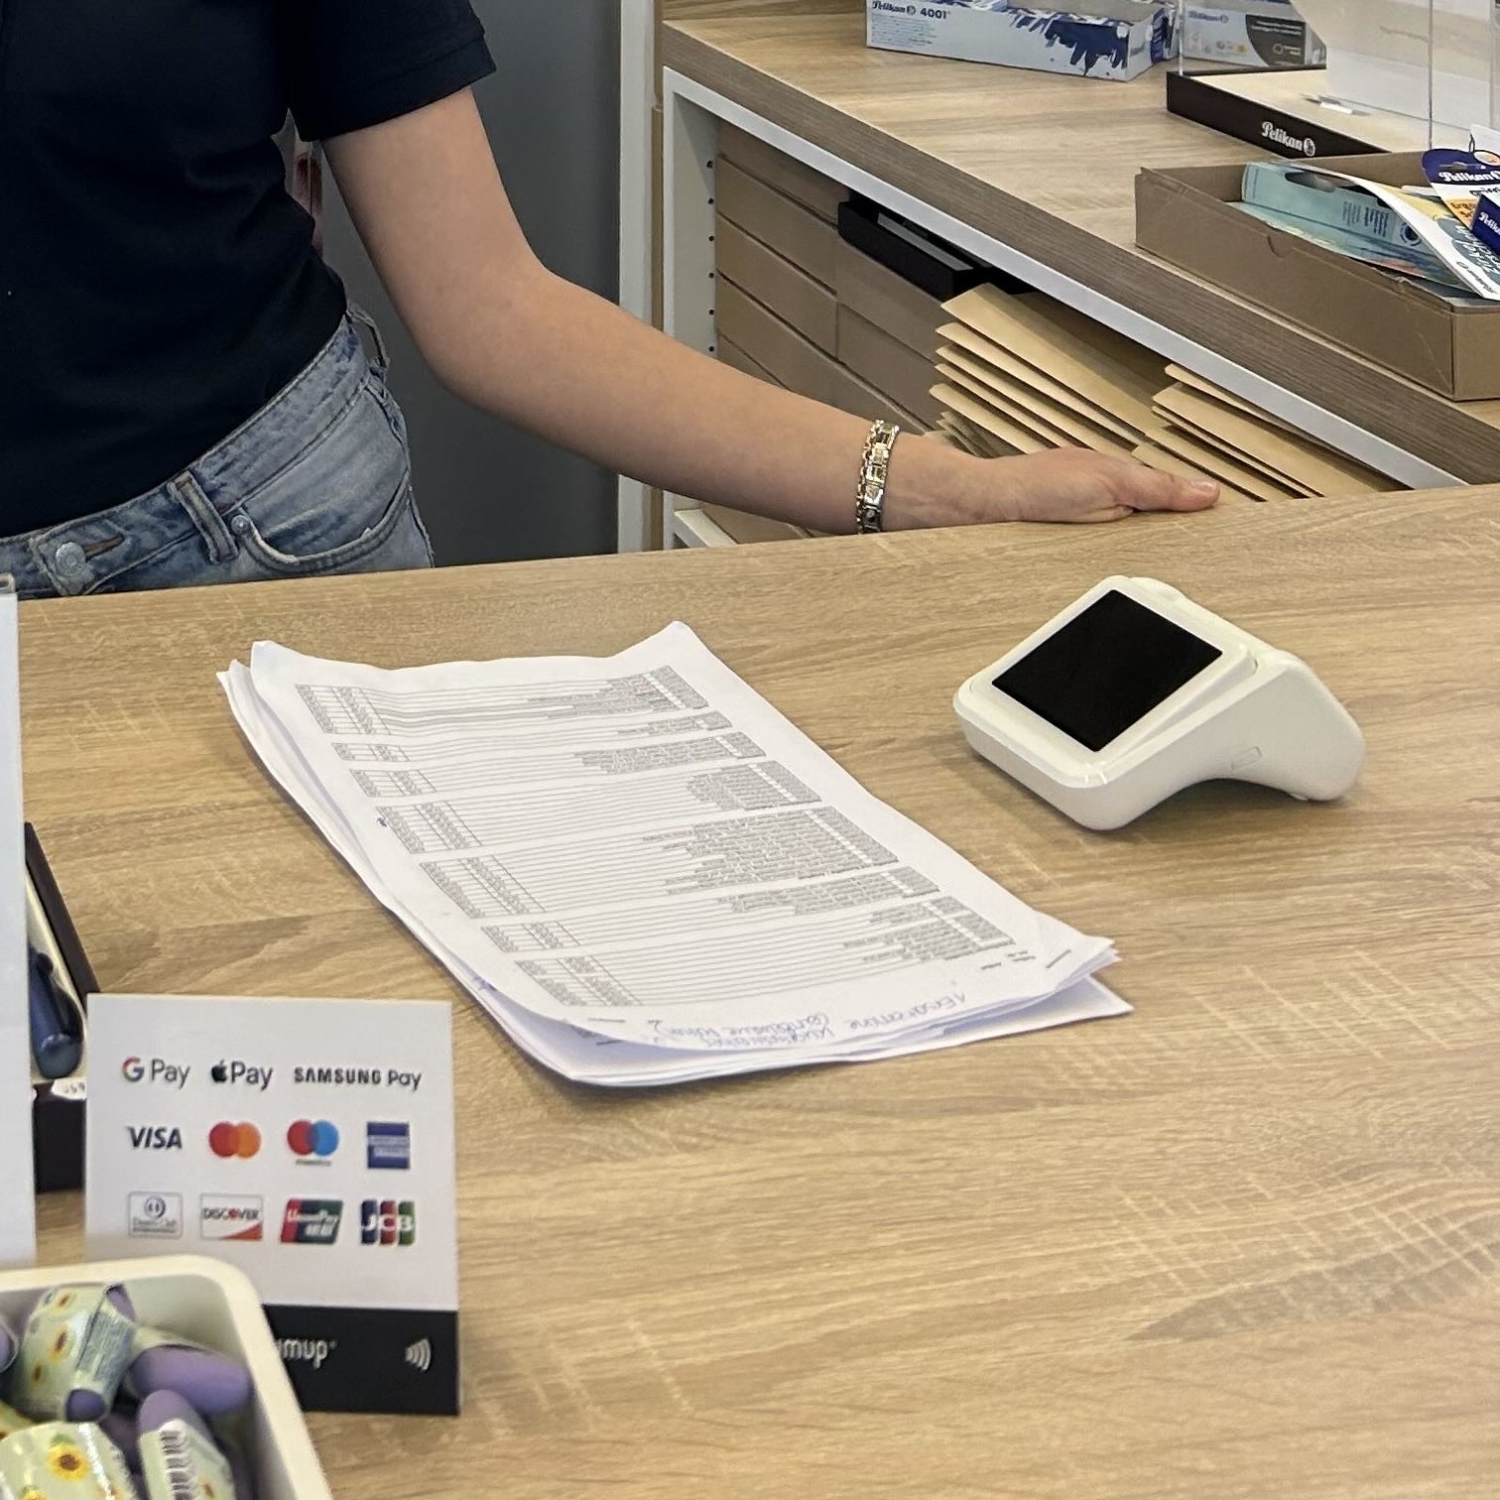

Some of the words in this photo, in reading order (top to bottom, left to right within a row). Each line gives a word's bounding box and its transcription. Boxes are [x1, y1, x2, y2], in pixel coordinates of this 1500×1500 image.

[920, 8, 947, 20] 4001
[1262, 121, 1303, 151] Pelikan
[151, 1059, 191, 1089] Pay
[231, 1061, 274, 1090] Pay
[294, 1066, 382, 1086] SAMSUNG
[388, 1069, 422, 1091] Pay
[127, 1126, 183, 1150] VISA
[202, 1207, 260, 1220] DISCOVER
[361, 1214, 416, 1232] JCB
